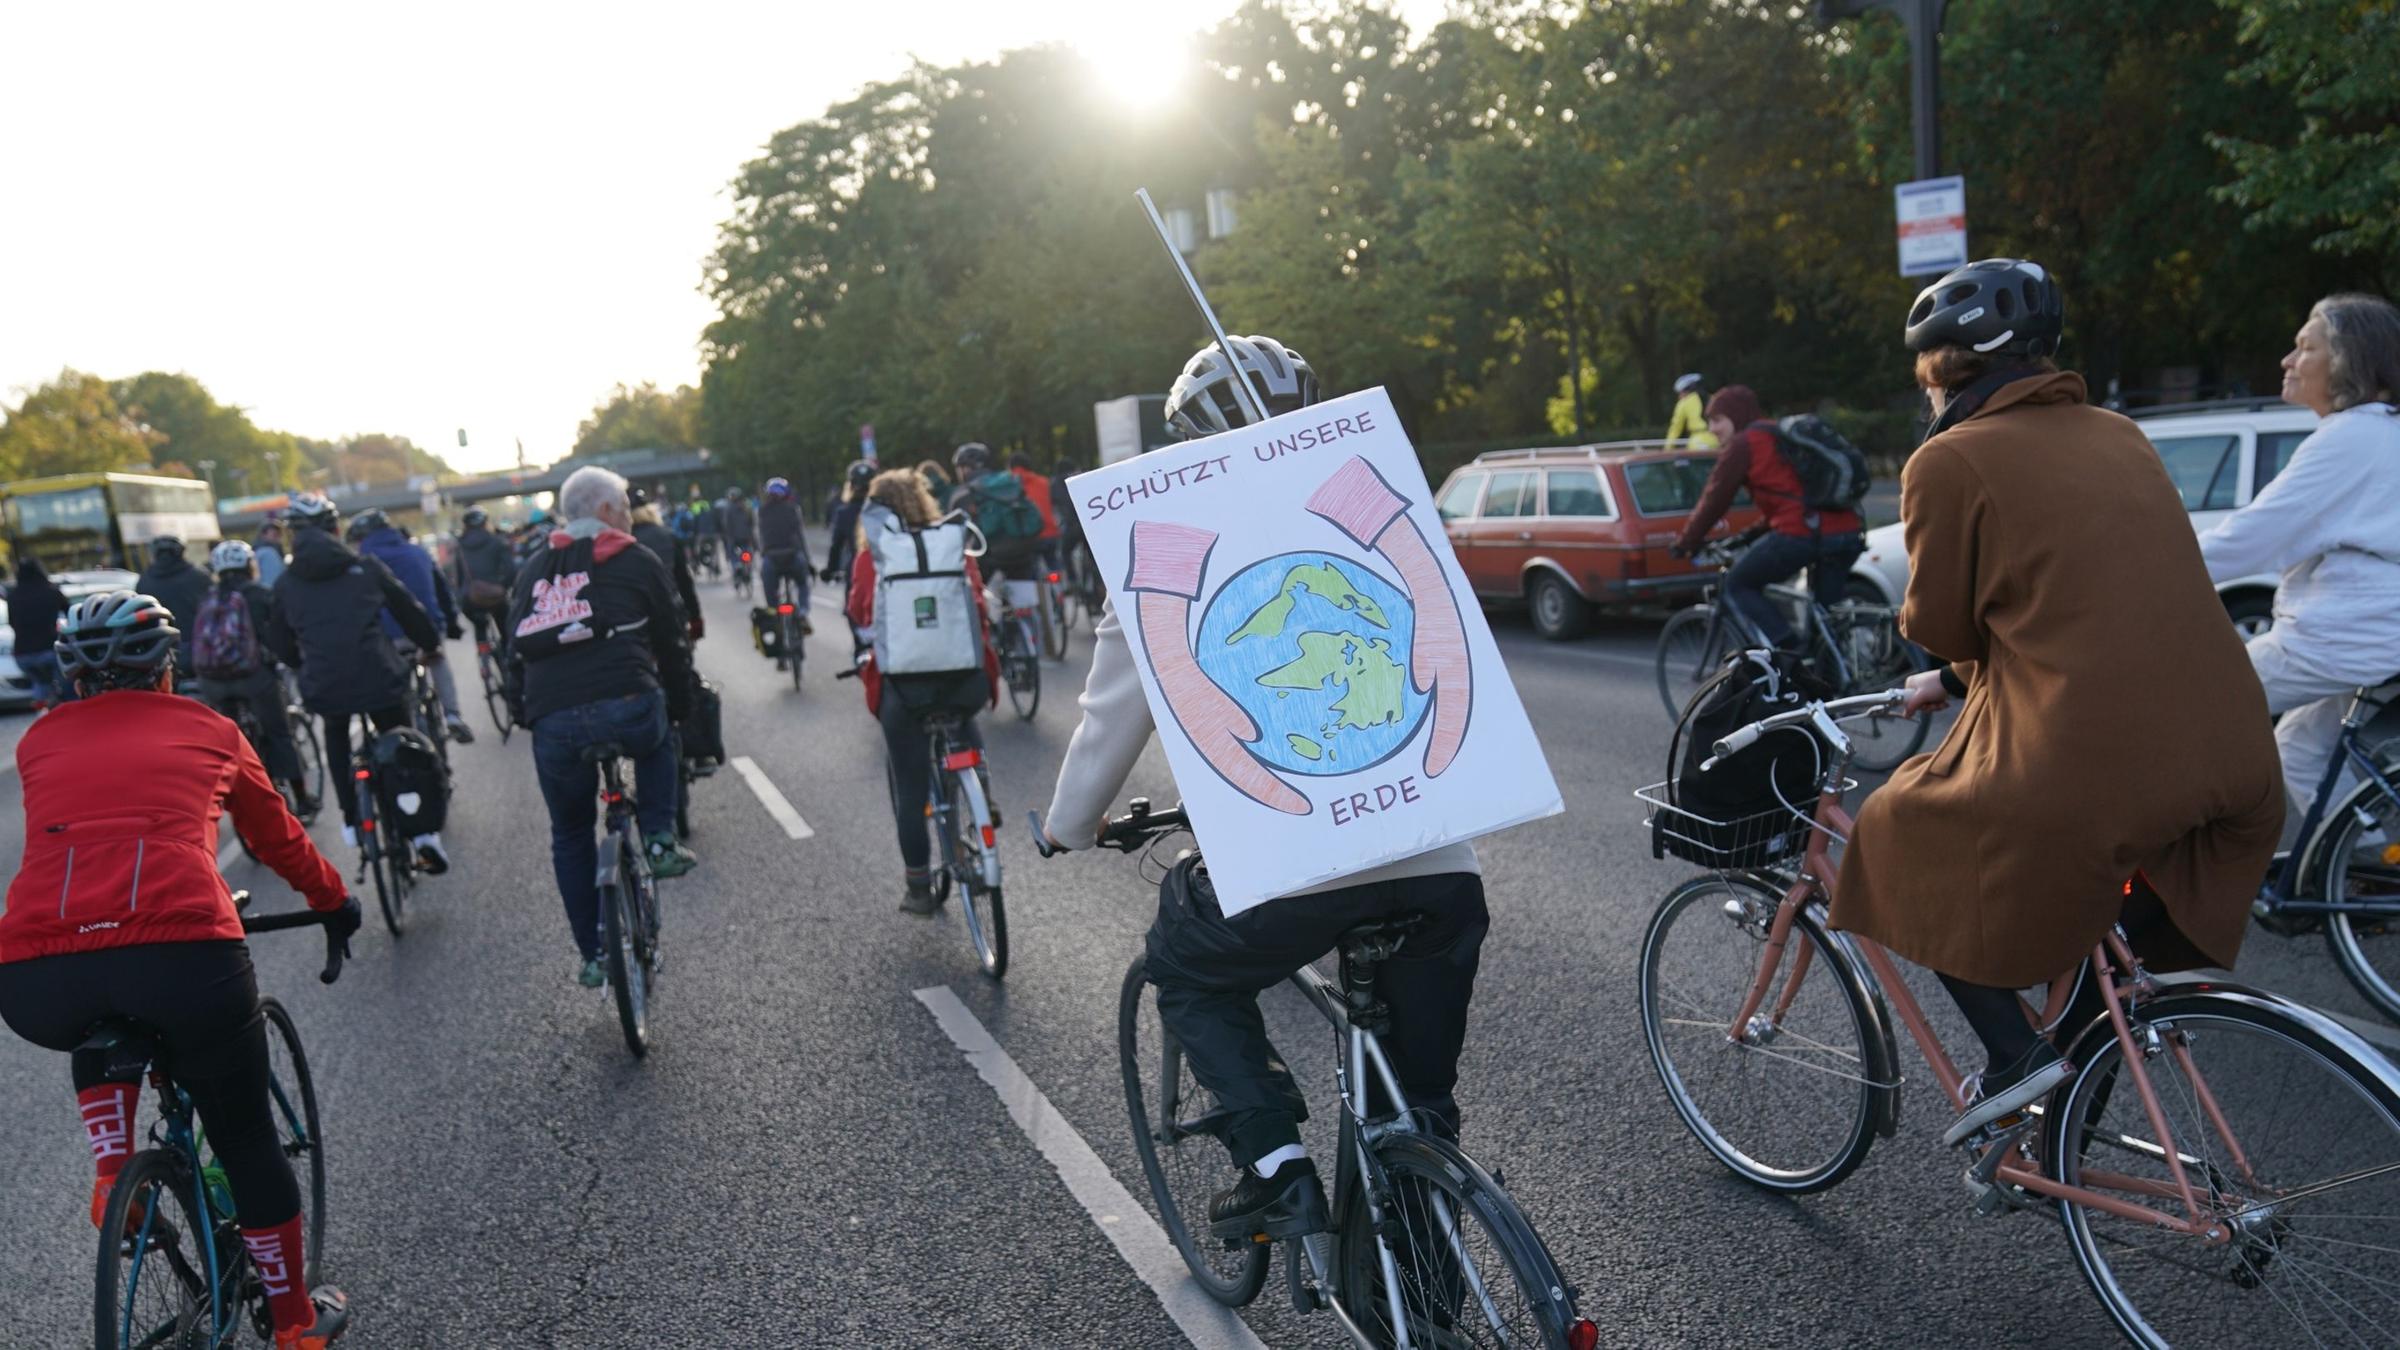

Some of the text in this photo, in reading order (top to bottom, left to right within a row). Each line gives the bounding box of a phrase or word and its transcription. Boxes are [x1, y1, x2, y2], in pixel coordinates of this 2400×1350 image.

[1087, 411, 1376, 520] SCHÜTZT UNSERE
[1329, 775, 1420, 826] ERDE
[80, 1089, 127, 1160] HELL
[242, 1233, 290, 1297] YEAH
